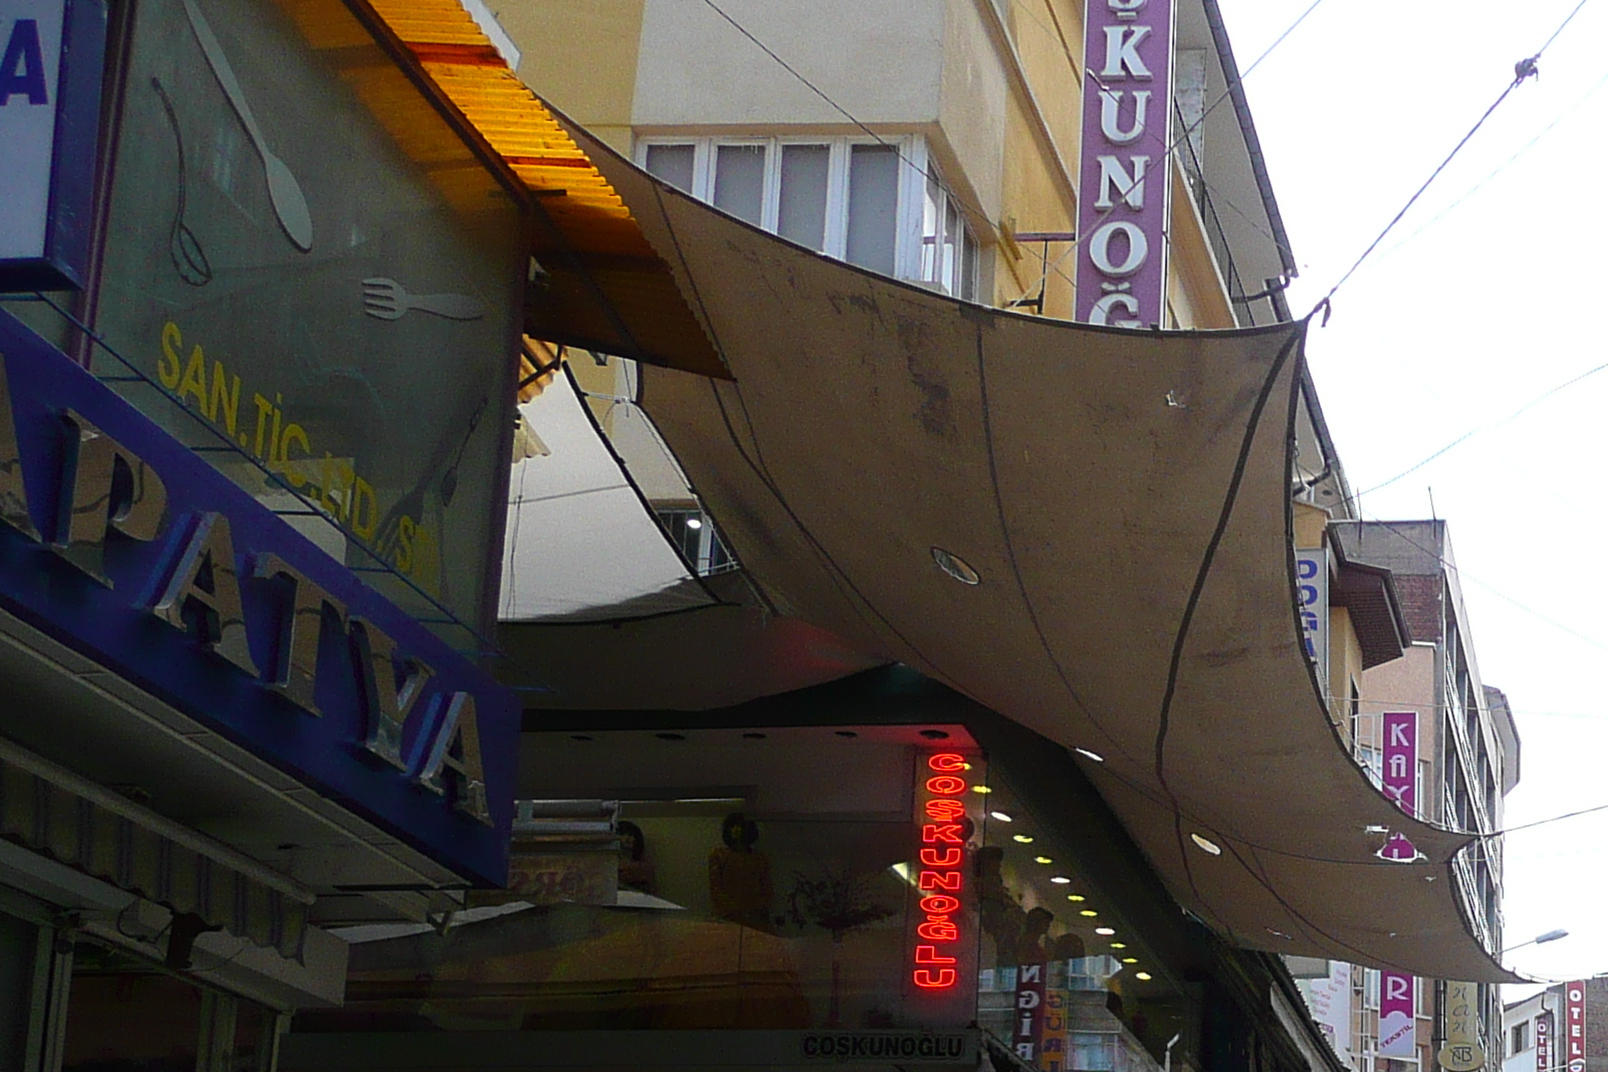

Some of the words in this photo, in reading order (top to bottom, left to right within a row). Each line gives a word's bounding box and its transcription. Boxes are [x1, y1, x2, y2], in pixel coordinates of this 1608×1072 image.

[1088, 0, 1152, 328] KUNOĞ
[1380, 1024, 1413, 1048] TEKSTİL
[1569, 989, 1582, 1055] OTEL
